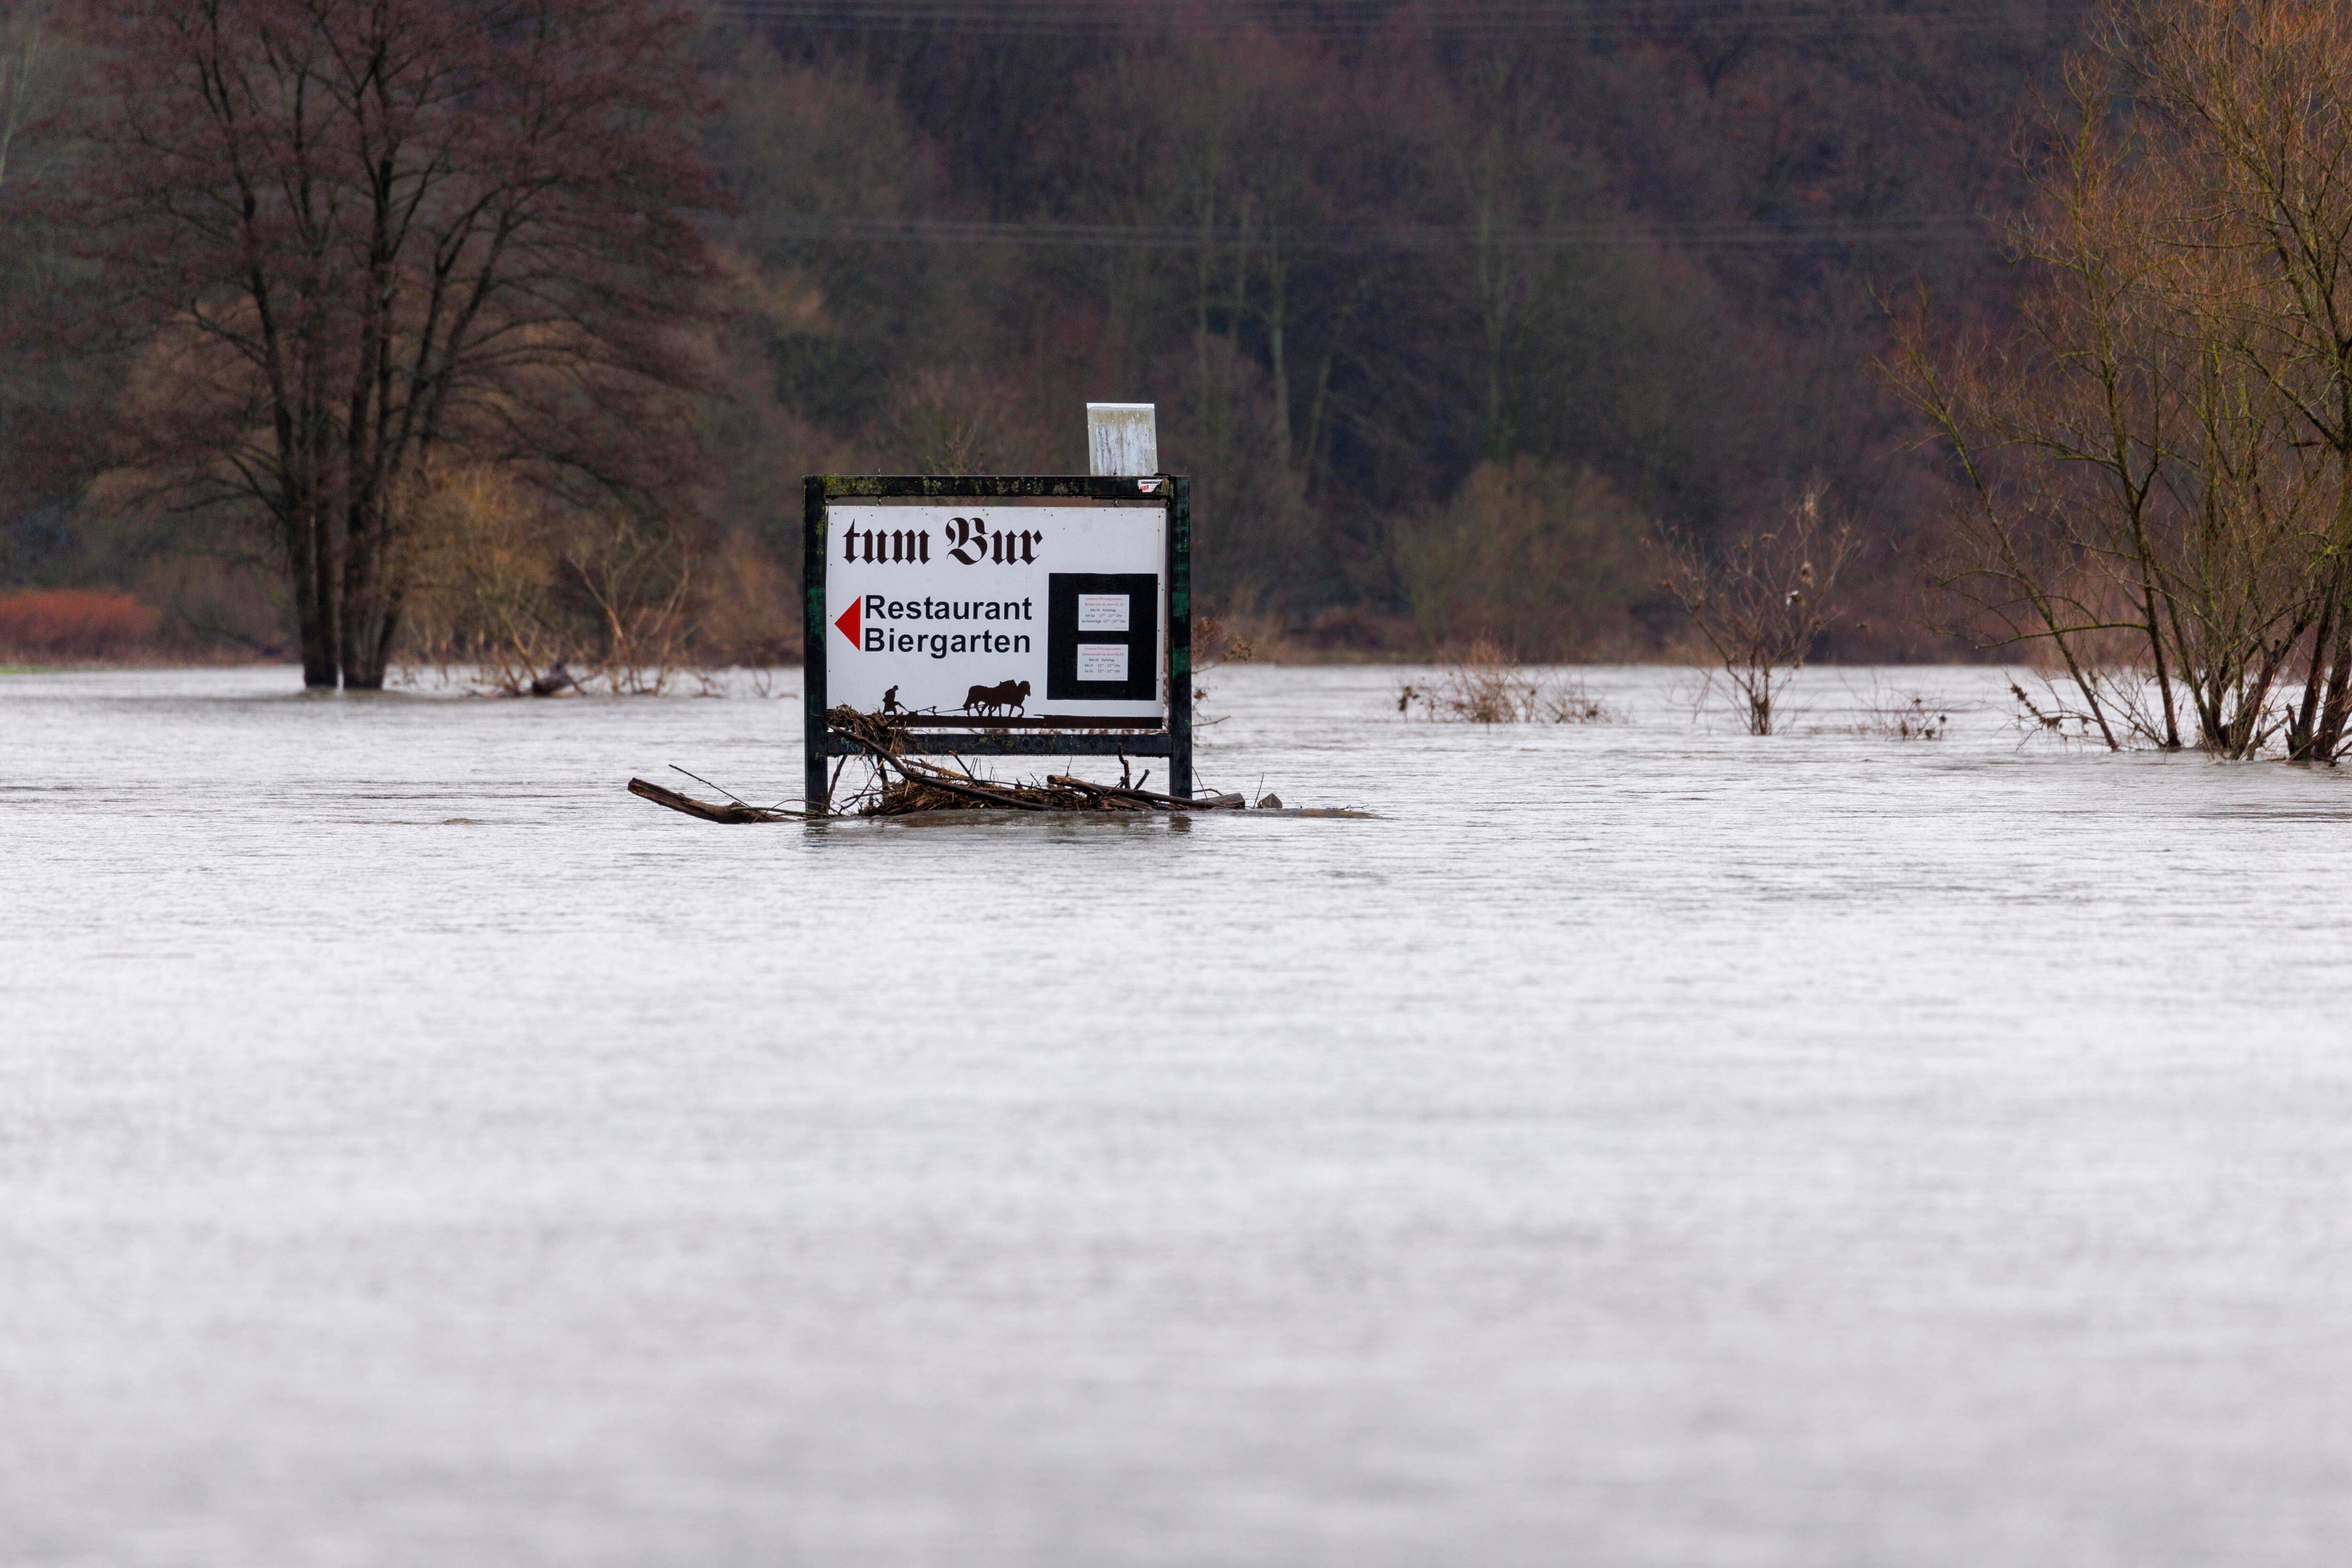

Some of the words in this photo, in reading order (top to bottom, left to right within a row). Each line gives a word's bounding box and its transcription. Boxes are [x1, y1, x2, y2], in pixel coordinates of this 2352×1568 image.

[842, 518, 931, 565] tum
[946, 517, 1043, 565] Bur
[865, 595, 1032, 620] Restaurant
[865, 628, 1030, 659] Biergarten
